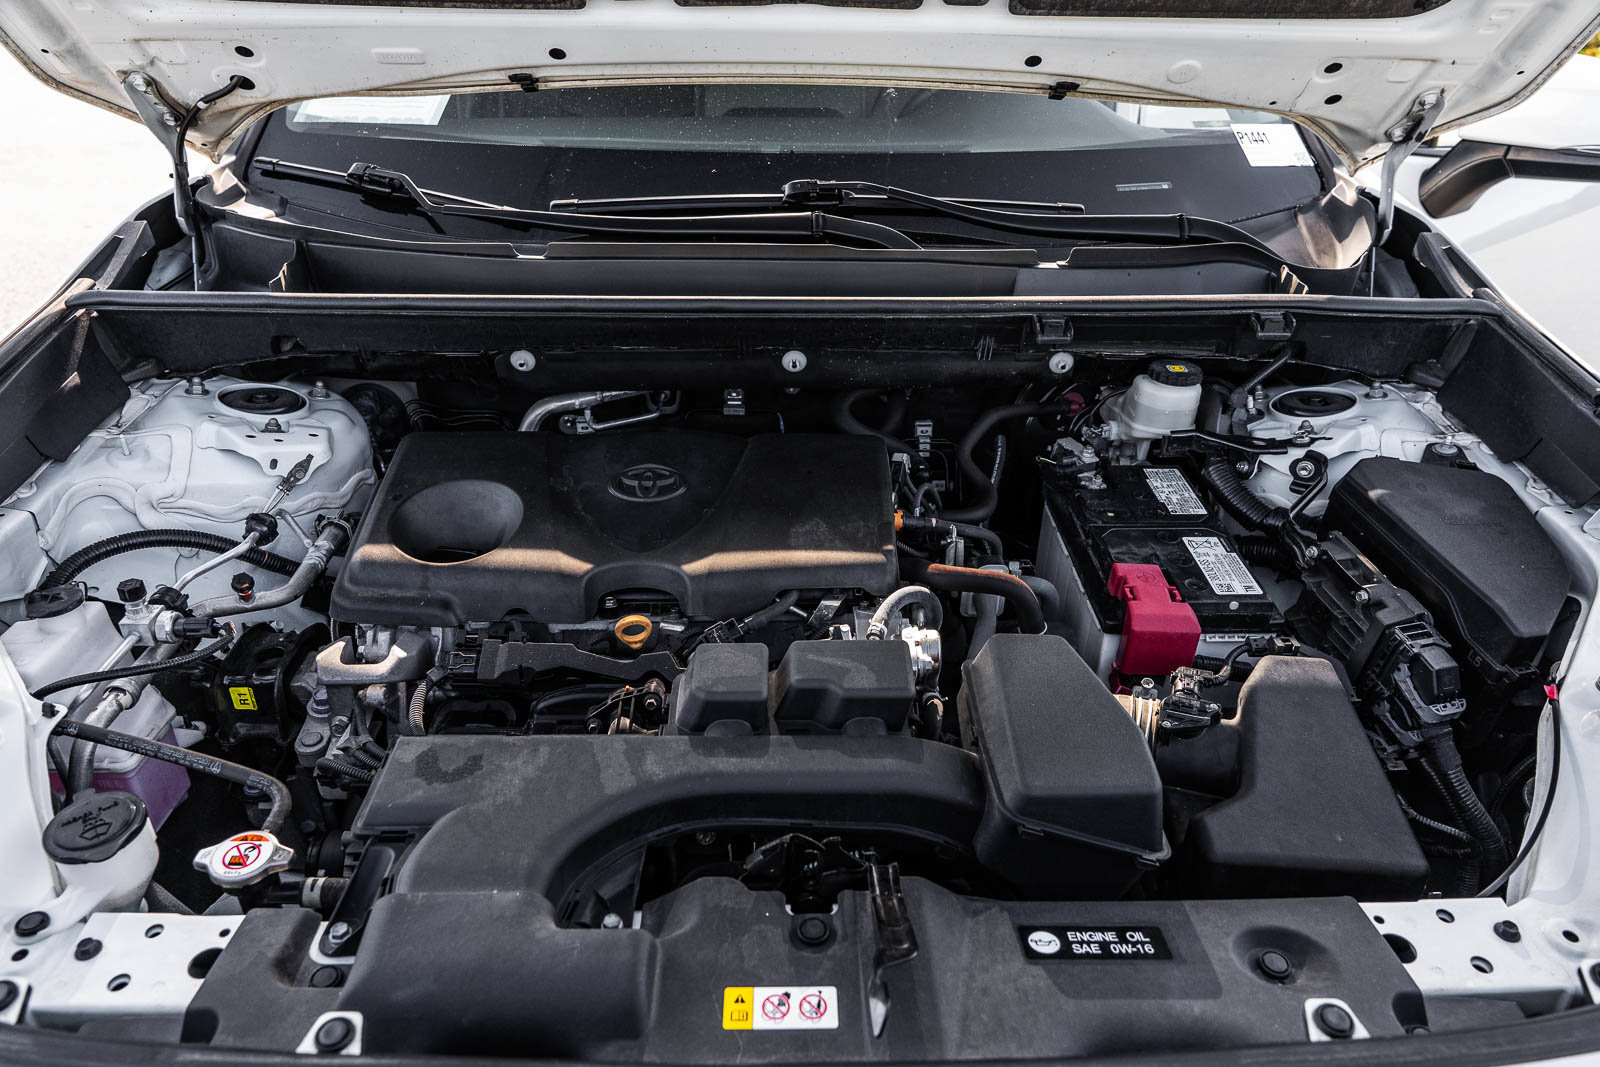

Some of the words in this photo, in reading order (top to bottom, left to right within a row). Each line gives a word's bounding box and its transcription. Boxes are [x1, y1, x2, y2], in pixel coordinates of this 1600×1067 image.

[1236, 131, 1271, 145] P1441
[238, 693, 249, 705] R1
[1066, 931, 1118, 942] ENGINE
[1126, 931, 1151, 942] OIL
[1071, 943, 1101, 954] SAE
[1110, 943, 1155, 954] 0W-16
